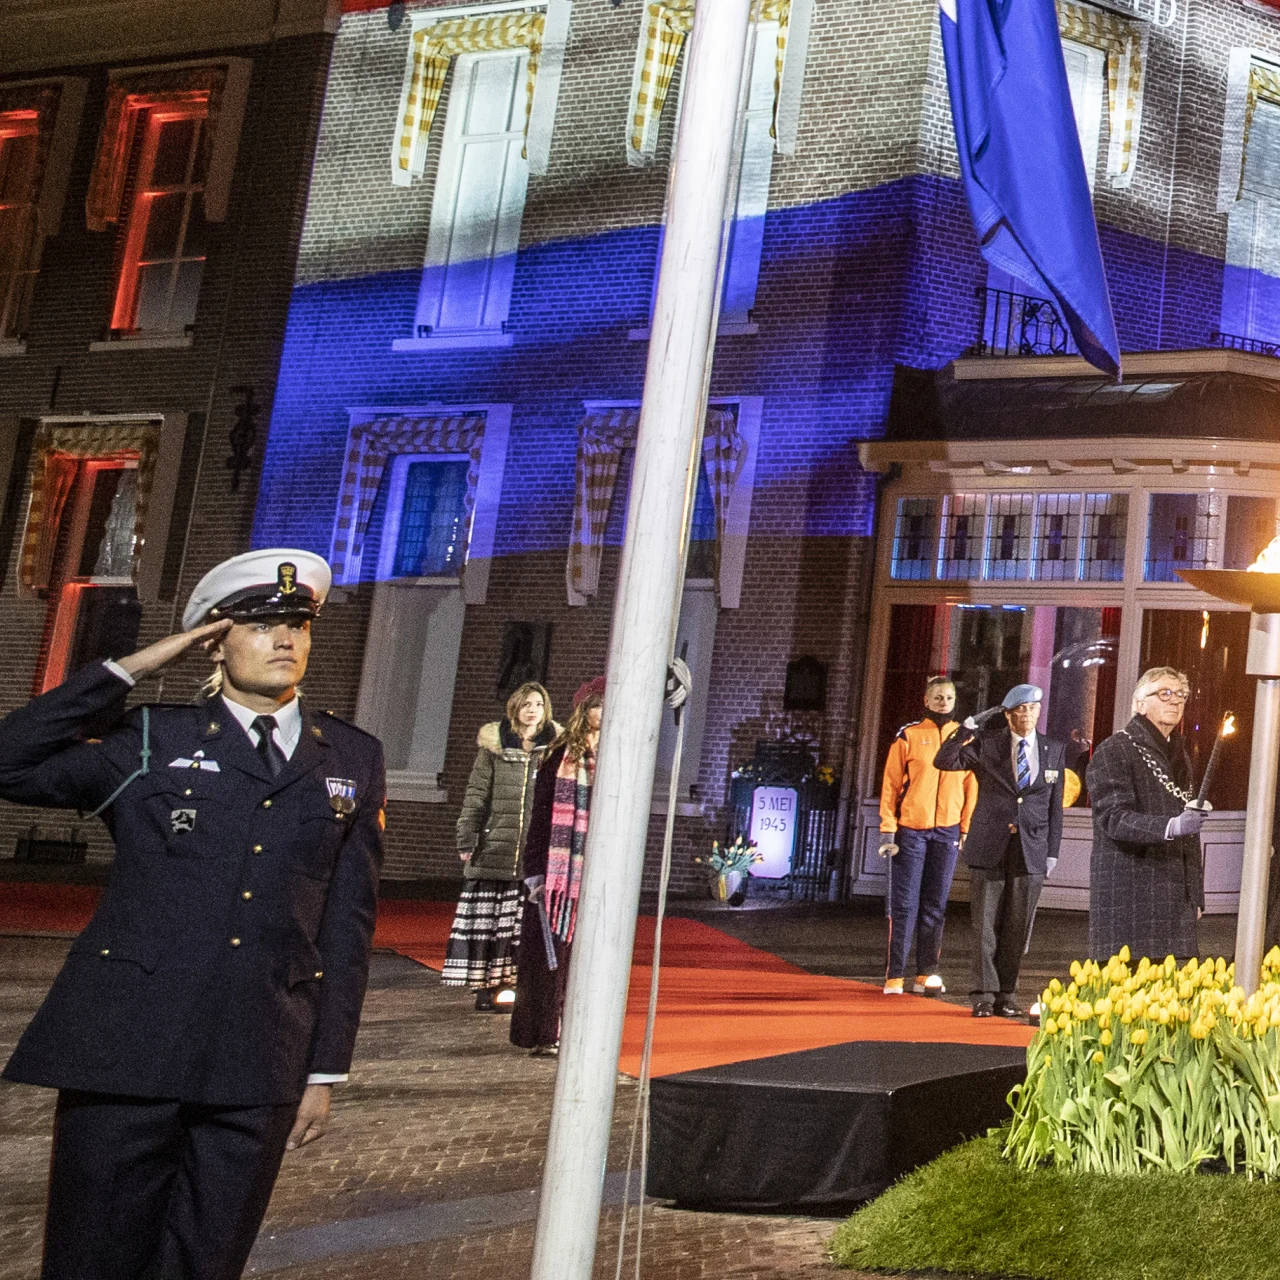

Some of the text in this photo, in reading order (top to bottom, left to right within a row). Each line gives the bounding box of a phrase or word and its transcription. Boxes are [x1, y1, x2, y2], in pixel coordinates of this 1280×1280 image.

[758, 796, 792, 812] 5 MEI
[760, 817, 787, 832] 1945
